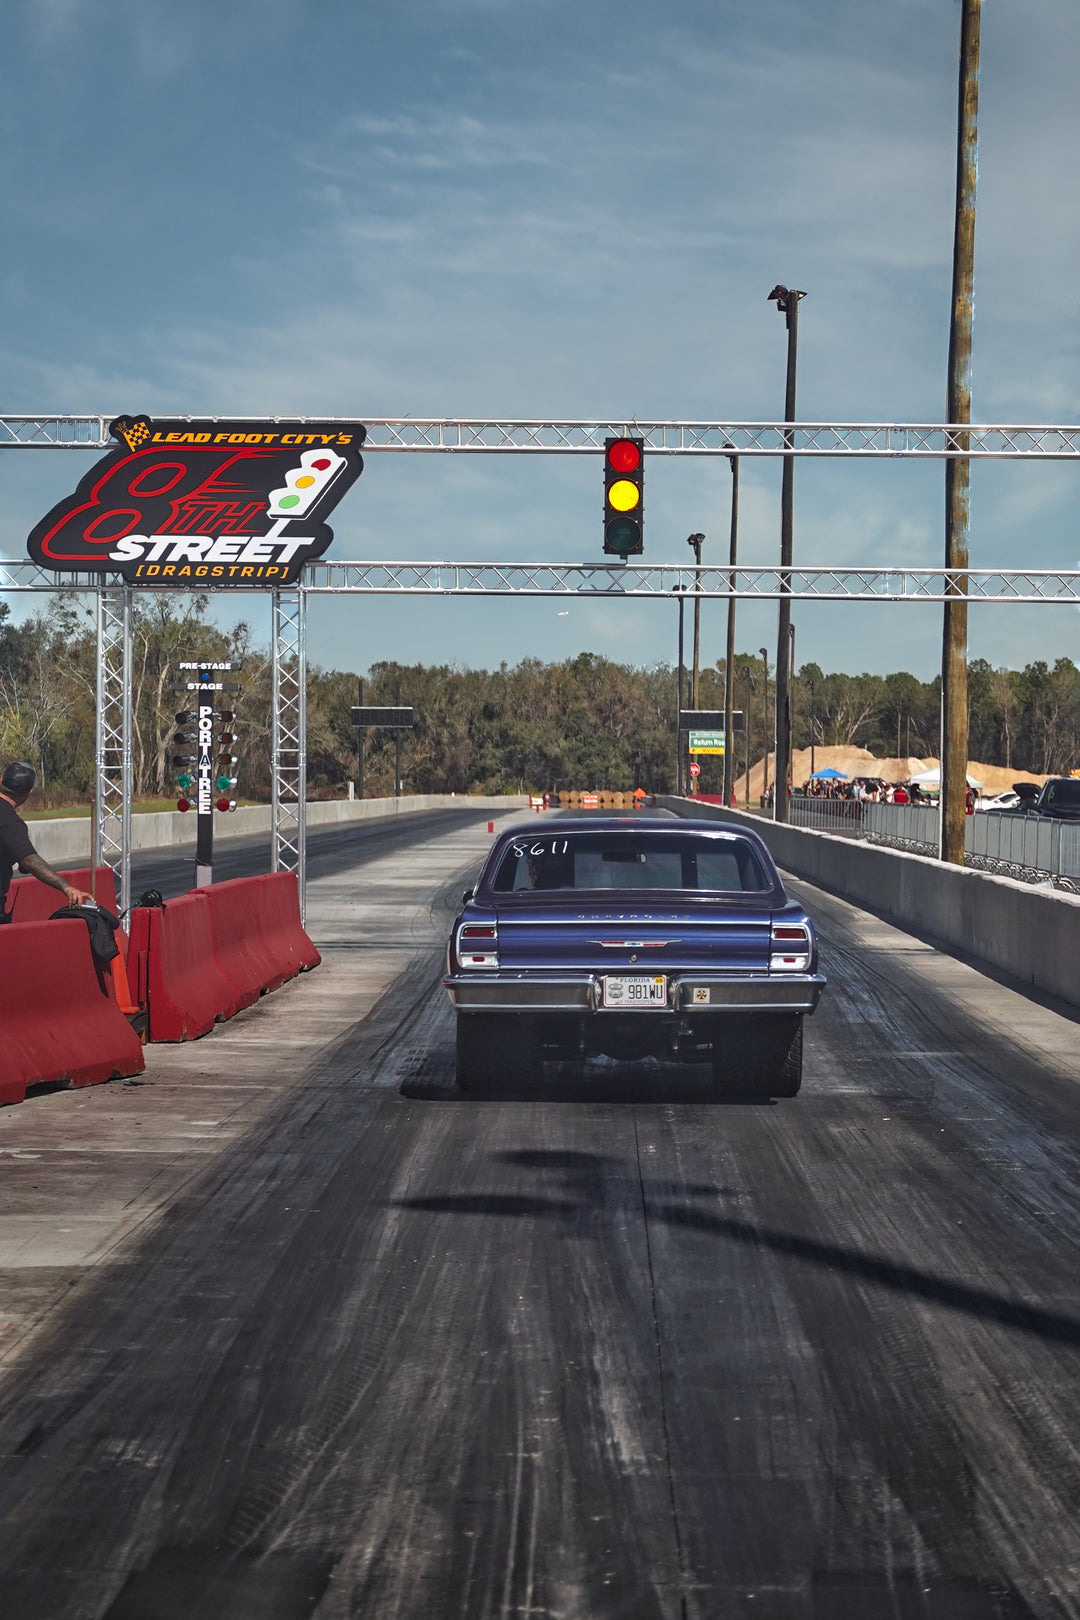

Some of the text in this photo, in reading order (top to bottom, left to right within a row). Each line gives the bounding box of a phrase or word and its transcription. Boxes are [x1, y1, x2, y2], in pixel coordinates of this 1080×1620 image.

[151, 432, 354, 445] LEAD FOOT CITY'S
[108, 534, 316, 563] STREET
[179, 662, 232, 670] PRE-STAGE
[187, 682, 224, 690] STAGE
[693, 738, 725, 746] Return Roa
[198, 705, 213, 815] PORTATREE
[513, 840, 568, 858] 8611
[628, 984, 663, 999] 981WU
